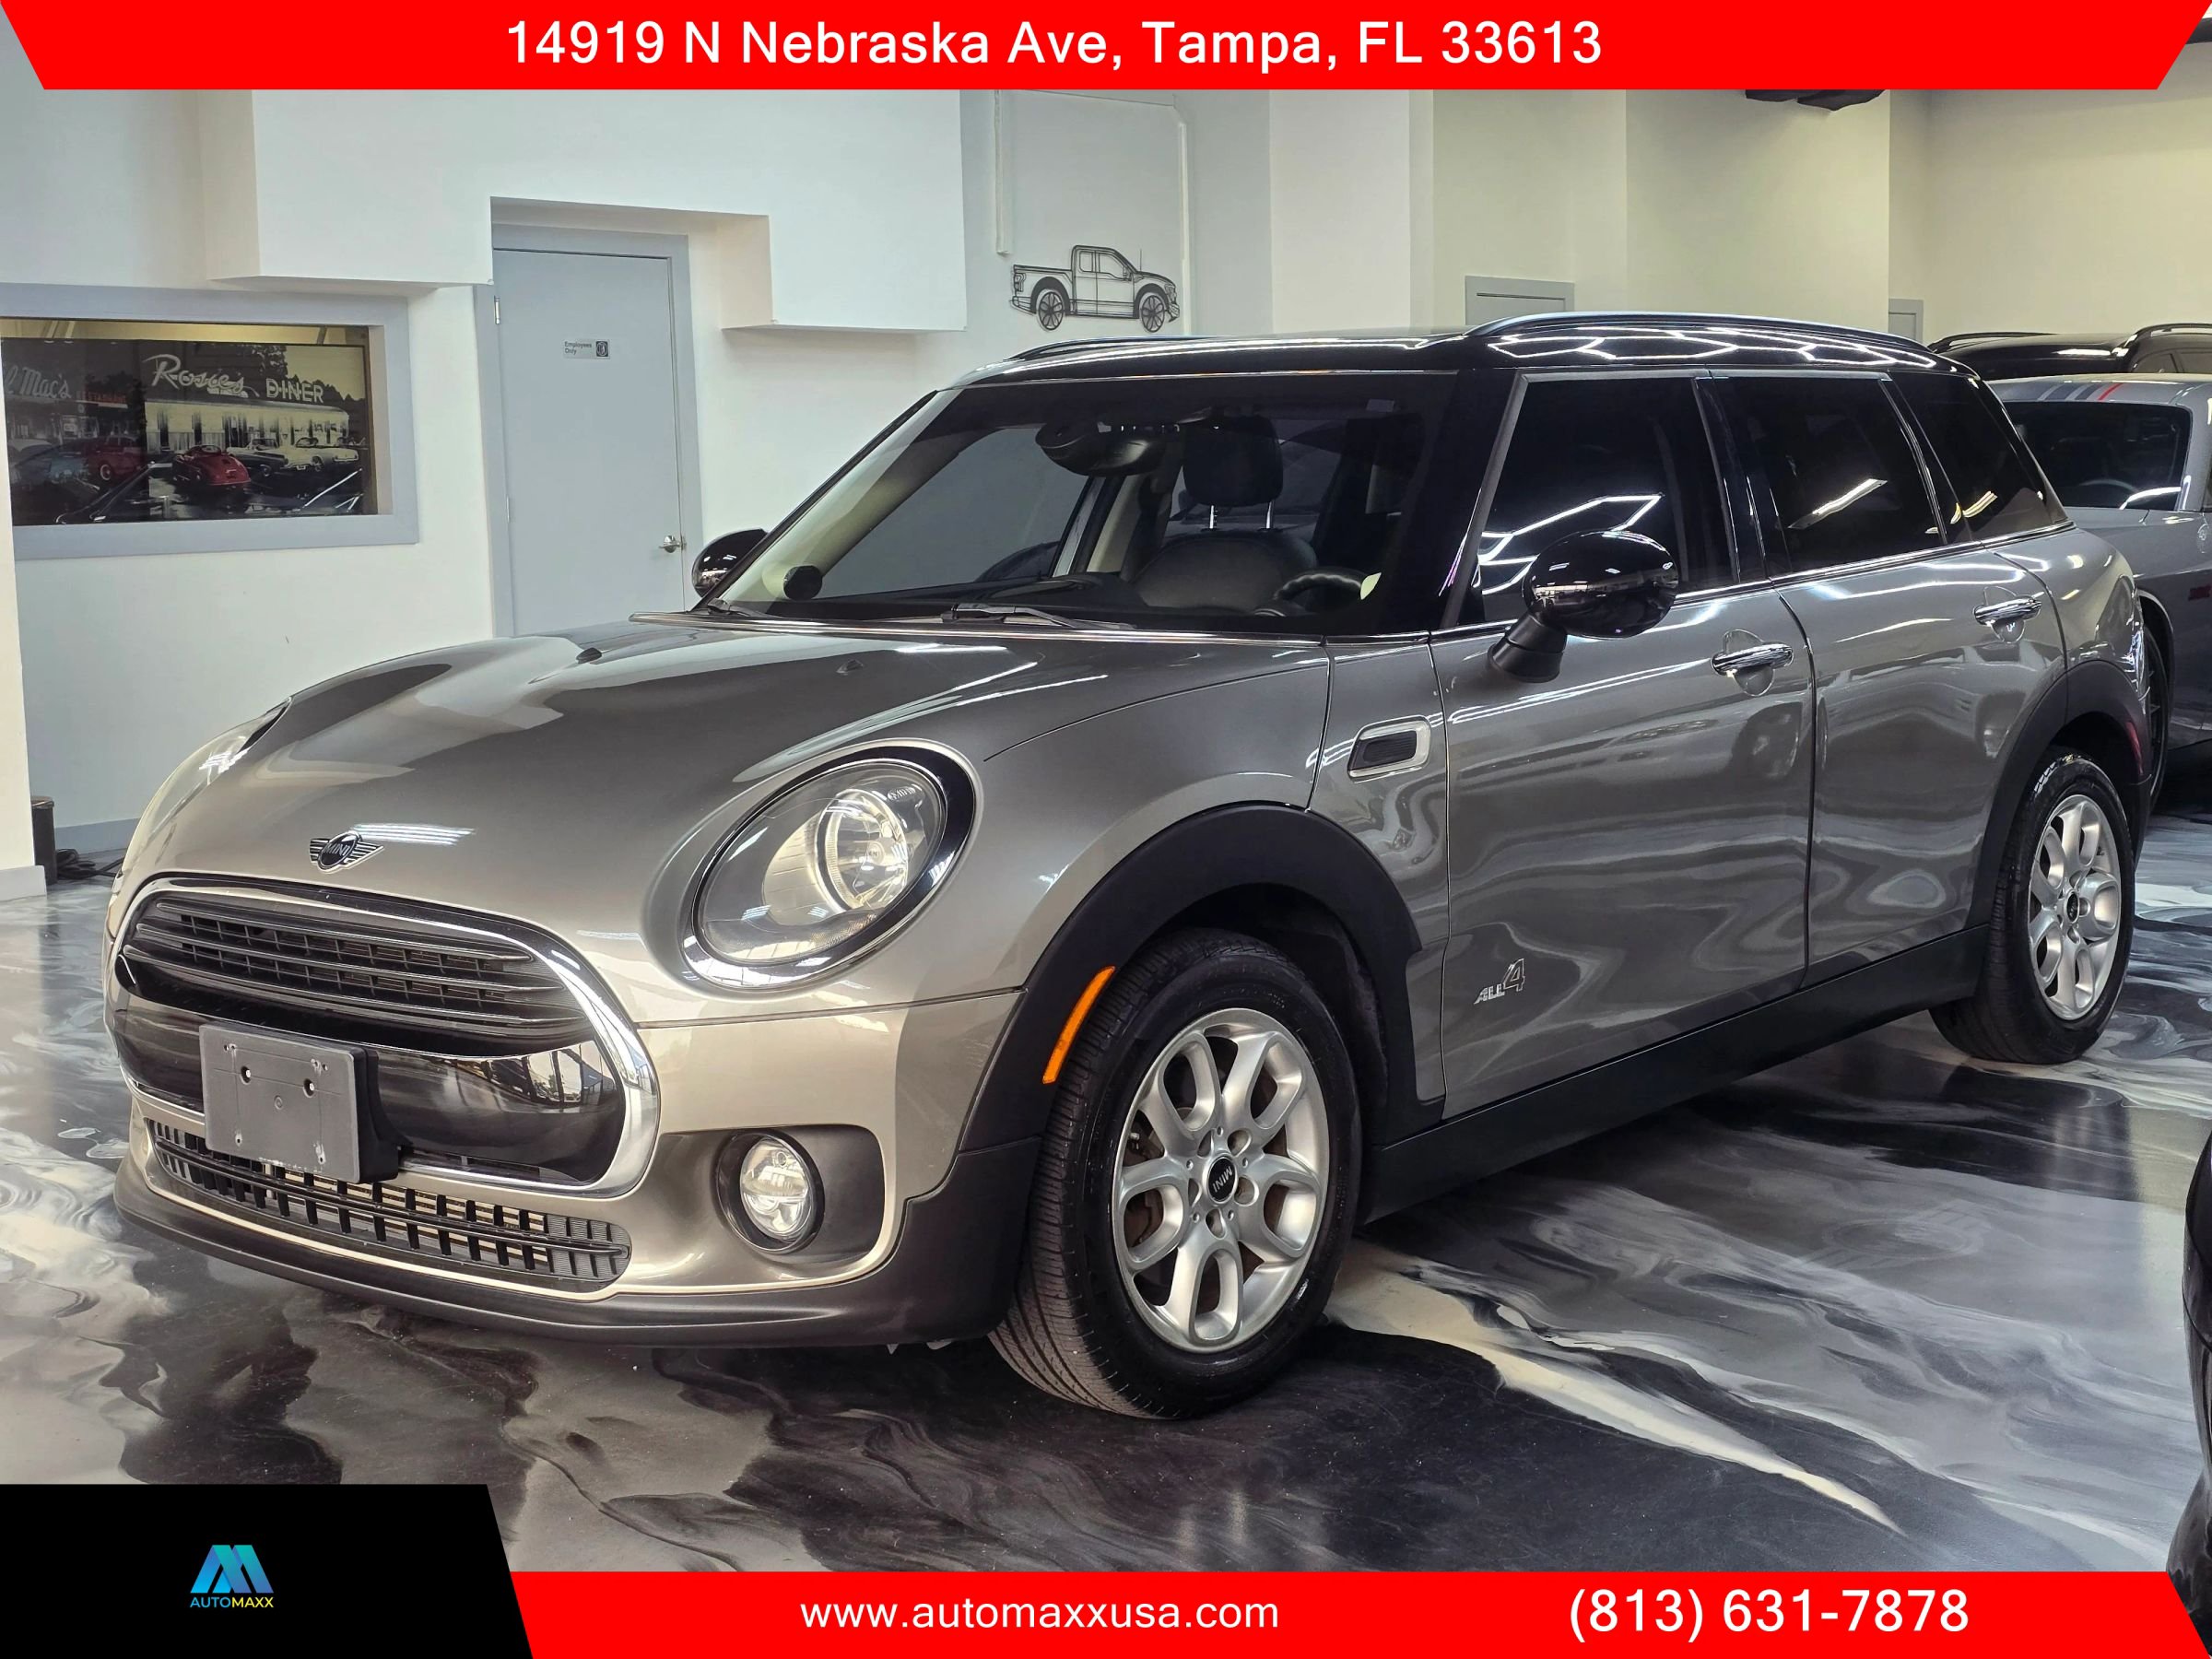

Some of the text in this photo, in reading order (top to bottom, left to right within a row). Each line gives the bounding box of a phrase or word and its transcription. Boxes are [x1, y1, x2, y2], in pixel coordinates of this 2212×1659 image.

[266, 378, 324, 404] DINER
[323, 842, 351, 856] MINI
[1212, 1166, 1233, 1193] MINI
